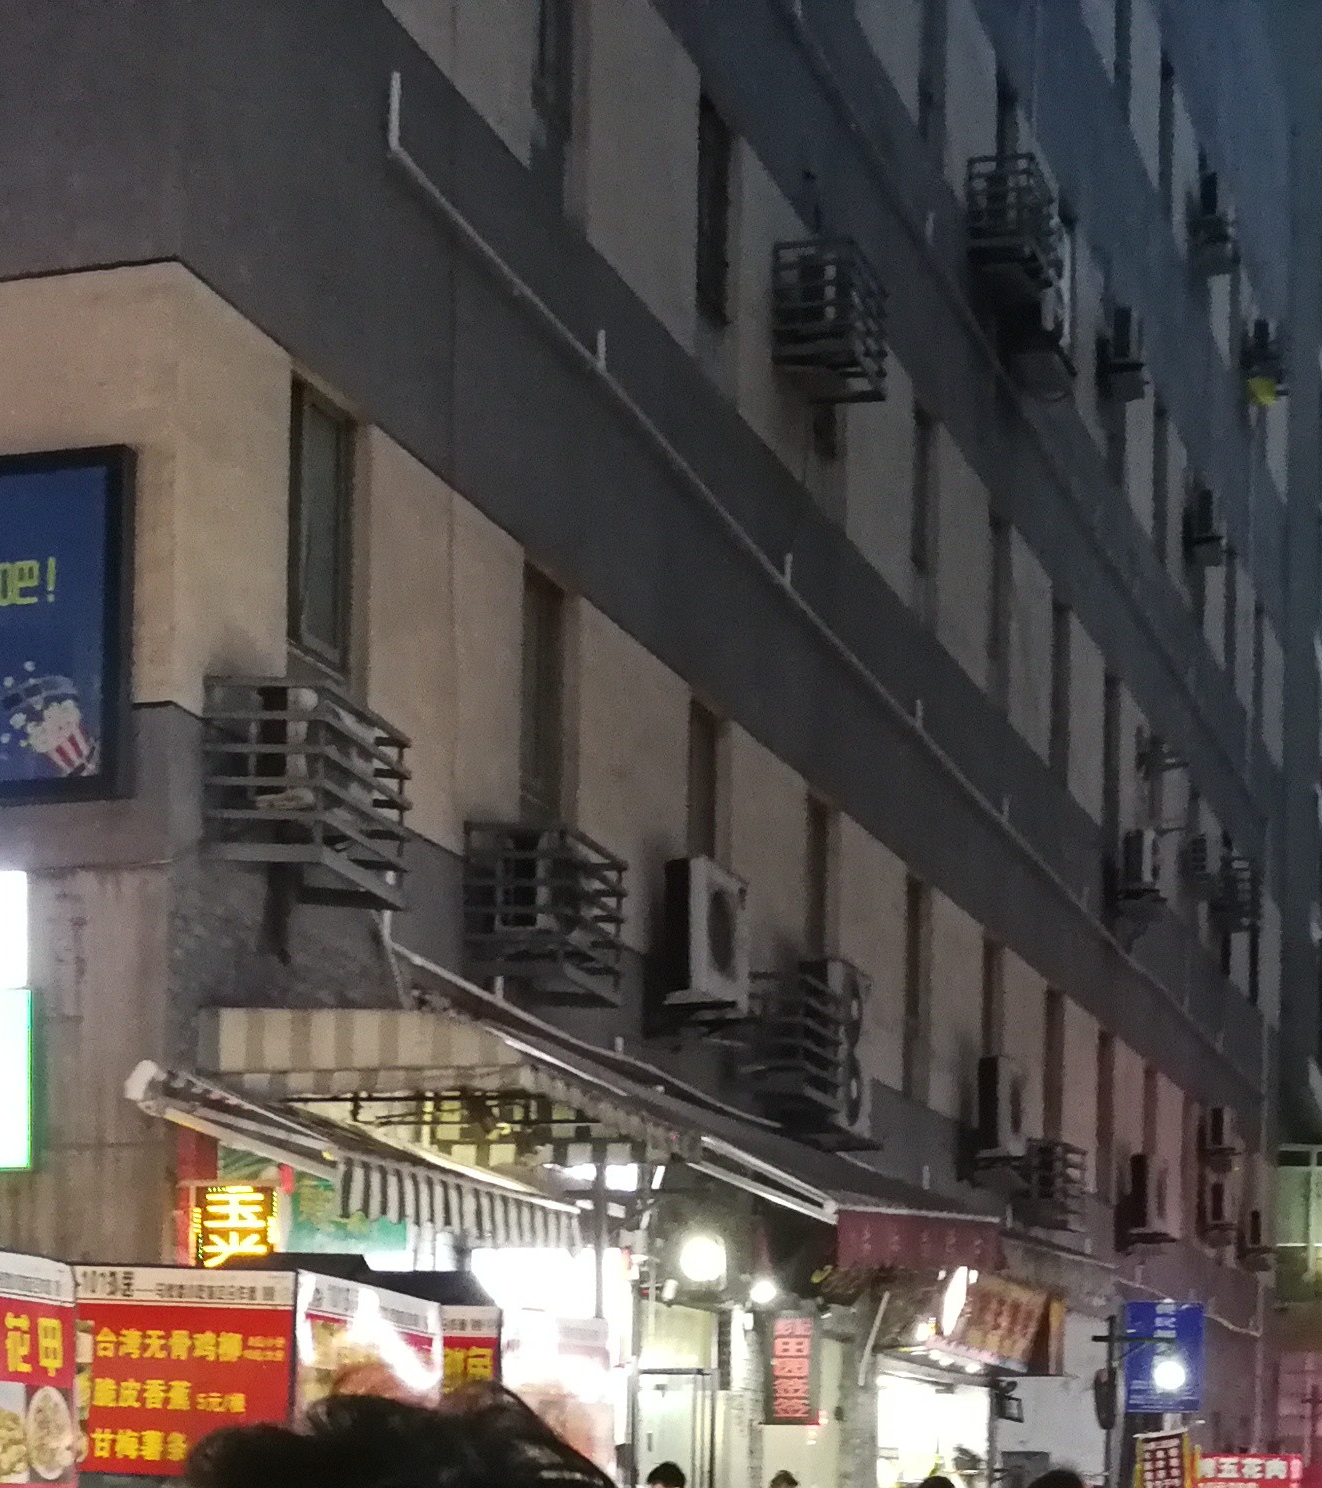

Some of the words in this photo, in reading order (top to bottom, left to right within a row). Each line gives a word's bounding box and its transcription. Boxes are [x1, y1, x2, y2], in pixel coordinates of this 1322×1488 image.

[95, 1327, 243, 1362] 台湾无骨鸡柳
[92, 1378, 192, 1411] 脆皮香蕉
